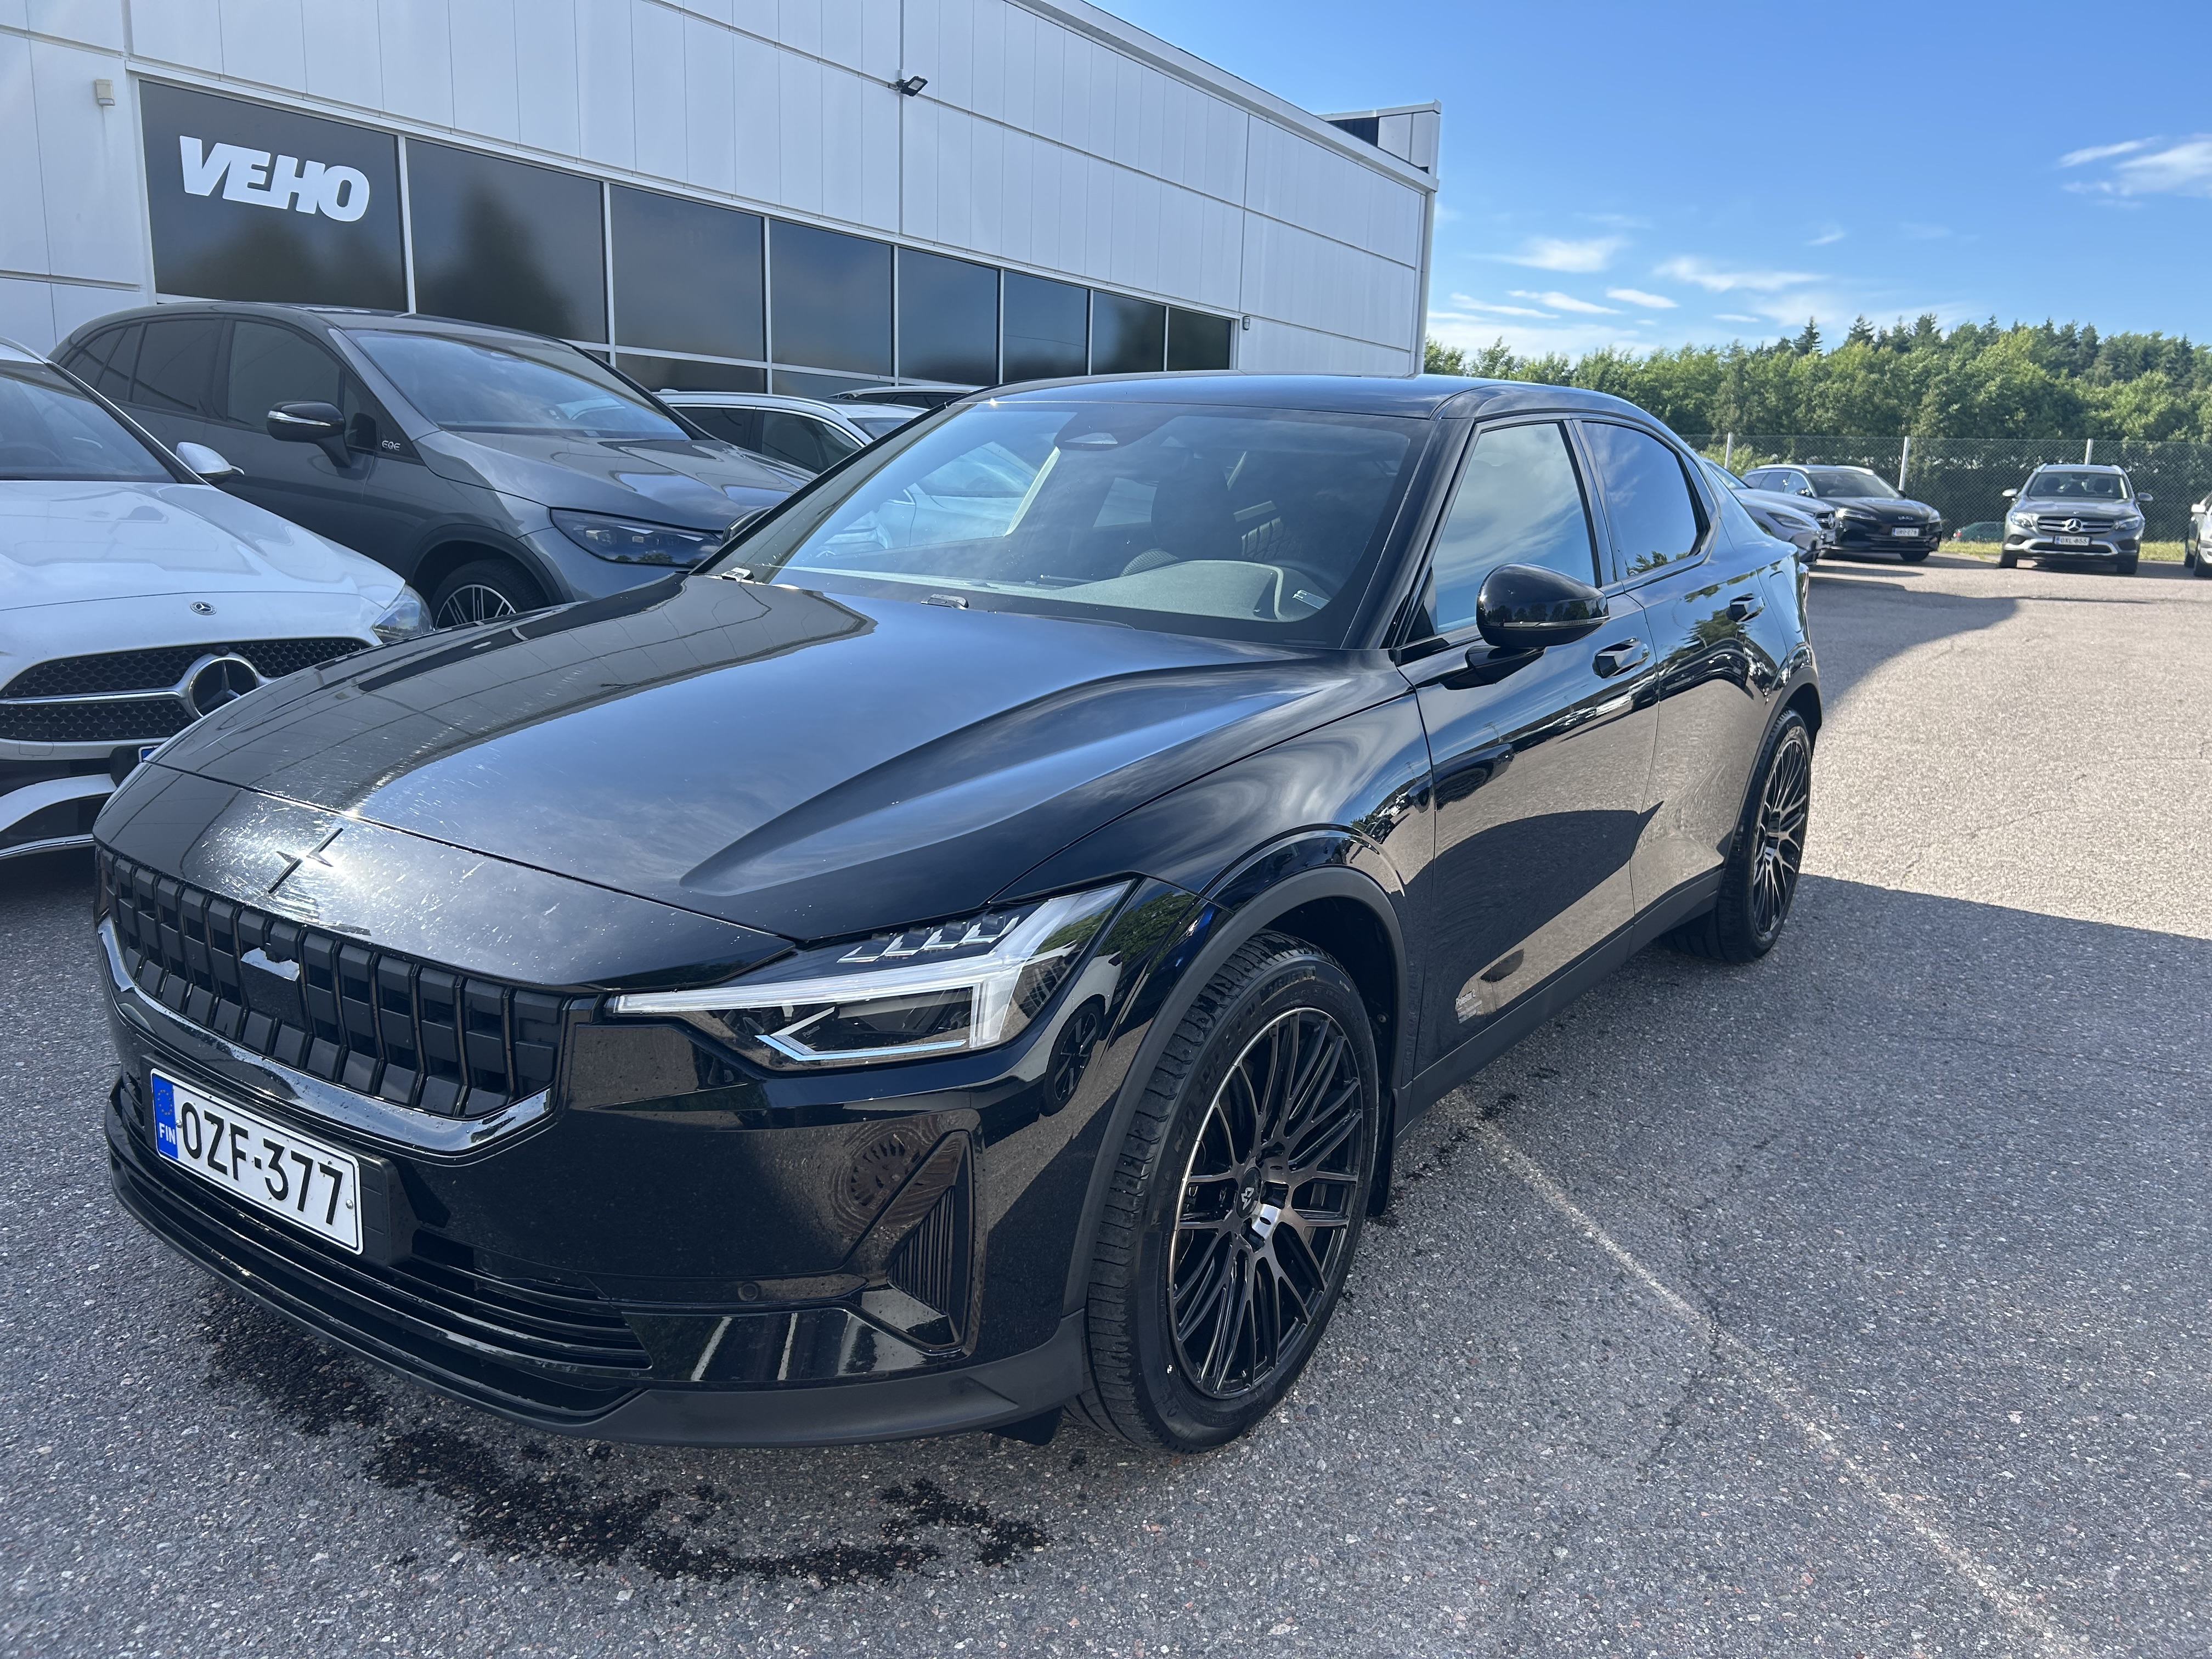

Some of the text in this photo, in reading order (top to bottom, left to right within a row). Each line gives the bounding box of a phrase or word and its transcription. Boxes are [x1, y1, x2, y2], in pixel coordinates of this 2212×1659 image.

[179, 135, 370, 222] VEHO
[381, 440, 400, 451] EQE
[1472, 989, 1476, 997] 2
[159, 1122, 176, 1145] FIN
[182, 1102, 344, 1226] OZF-377
